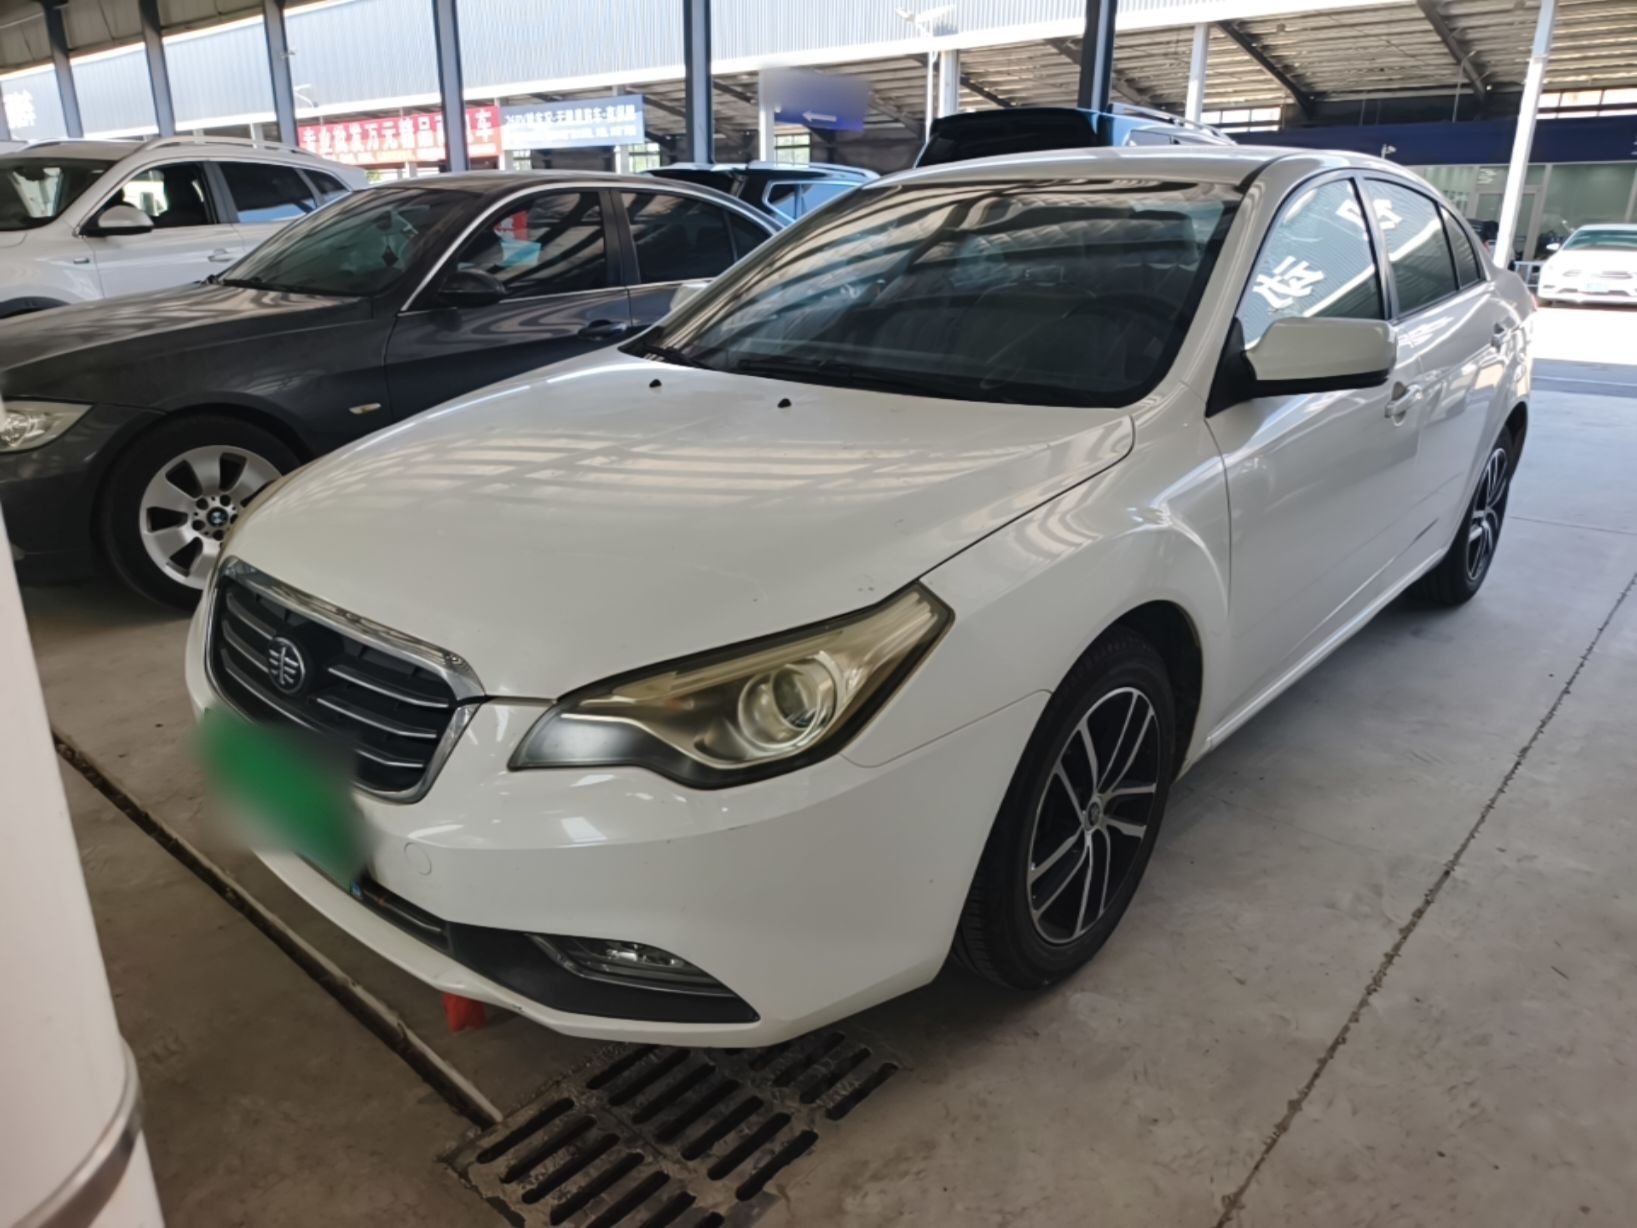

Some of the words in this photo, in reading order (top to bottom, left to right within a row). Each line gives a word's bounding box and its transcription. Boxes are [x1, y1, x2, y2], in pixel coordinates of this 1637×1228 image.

[303, 109, 492, 154] 专业批发万元精品车
